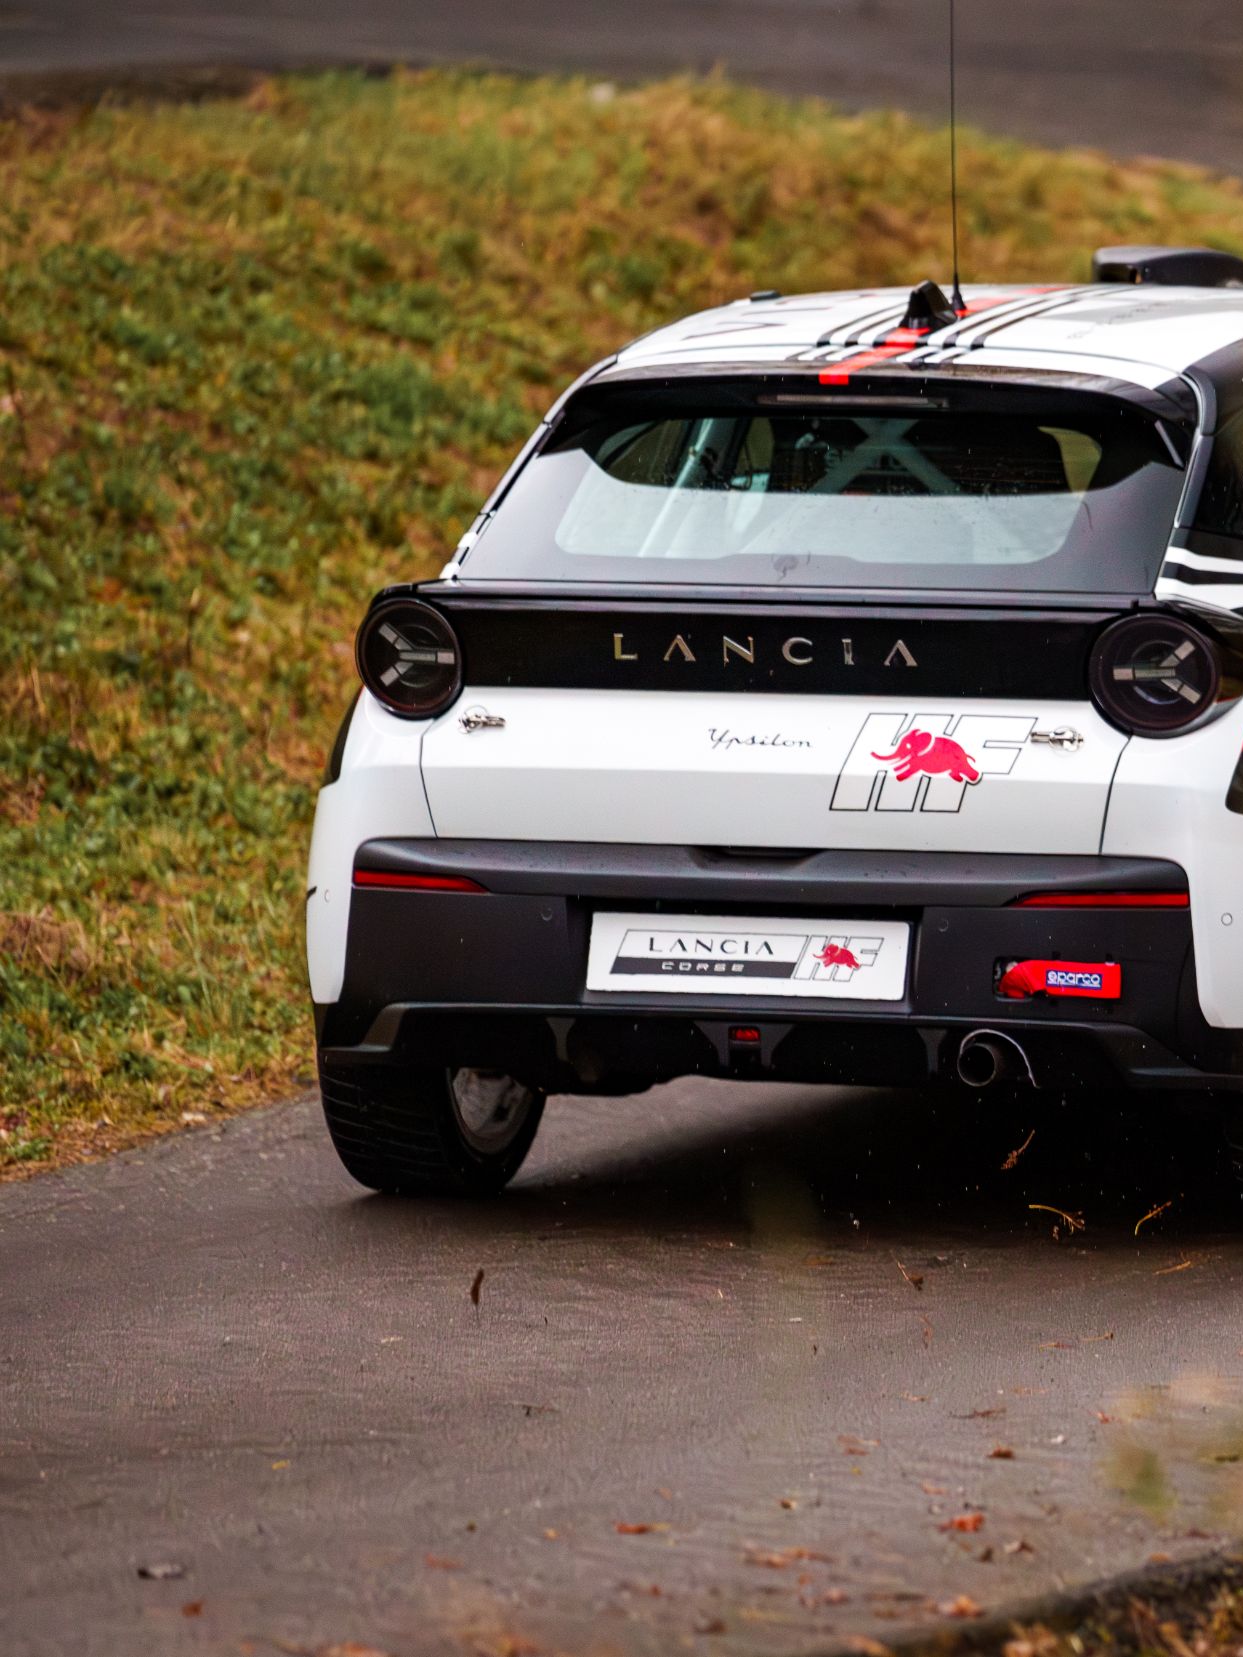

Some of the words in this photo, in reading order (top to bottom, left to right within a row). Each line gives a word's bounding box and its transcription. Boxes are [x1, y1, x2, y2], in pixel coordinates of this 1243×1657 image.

[613, 632, 919, 667] LANCIA
[708, 728, 812, 749] Ypsilon
[648, 937, 774, 955] LANCIA
[661, 961, 745, 972] CORSE
[1046, 970, 1102, 988] sparco
